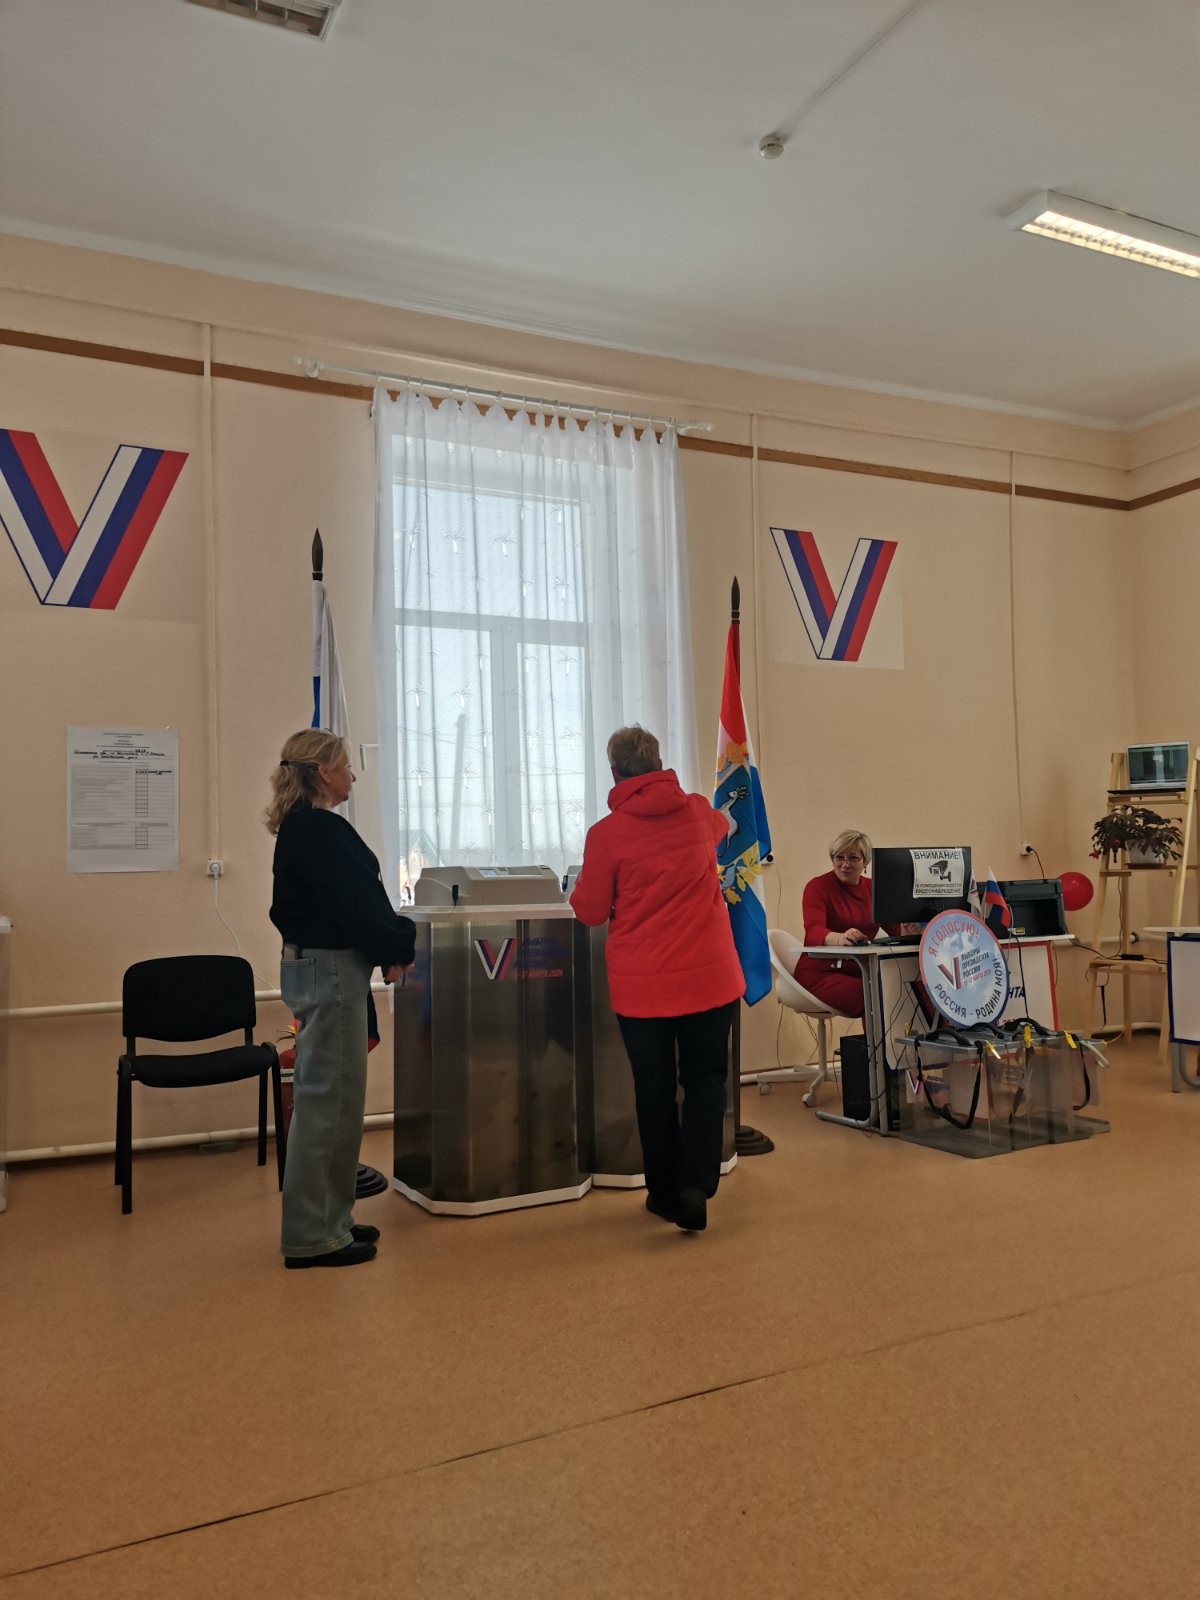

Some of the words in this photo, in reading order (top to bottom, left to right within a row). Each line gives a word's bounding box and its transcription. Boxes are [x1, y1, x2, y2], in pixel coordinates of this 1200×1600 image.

[931, 920, 980, 948] ГОЛОСУЮ!
[927, 946, 938, 957] Я
[961, 946, 981, 961] ВЫБОРЫ
[961, 951, 990, 969] ПРЕЗИДЕНТА
[962, 965, 981, 979] РОССИИ
[934, 983, 967, 1019] РОССИЯ
[975, 989, 1002, 1019] РОДИНА
